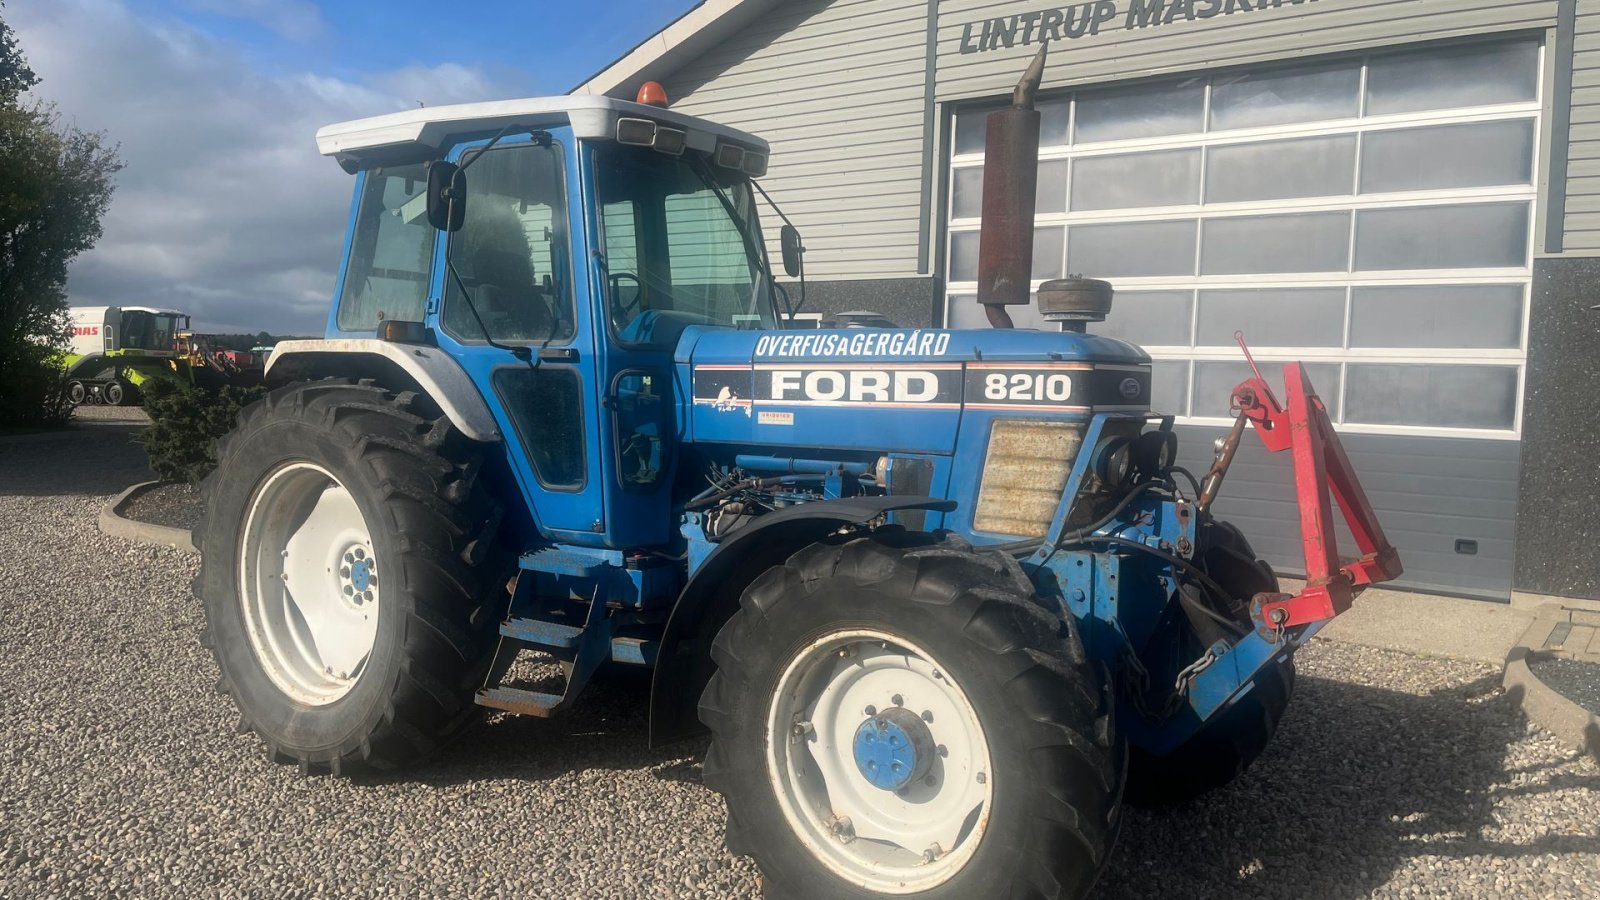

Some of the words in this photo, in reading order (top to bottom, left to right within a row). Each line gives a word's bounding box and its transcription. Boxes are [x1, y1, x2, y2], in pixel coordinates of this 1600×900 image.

[959, 2, 1116, 55] LINTRUP
[65, 326, 99, 336] AAS
[771, 370, 939, 402] FORD
[984, 373, 1072, 402] 8210
